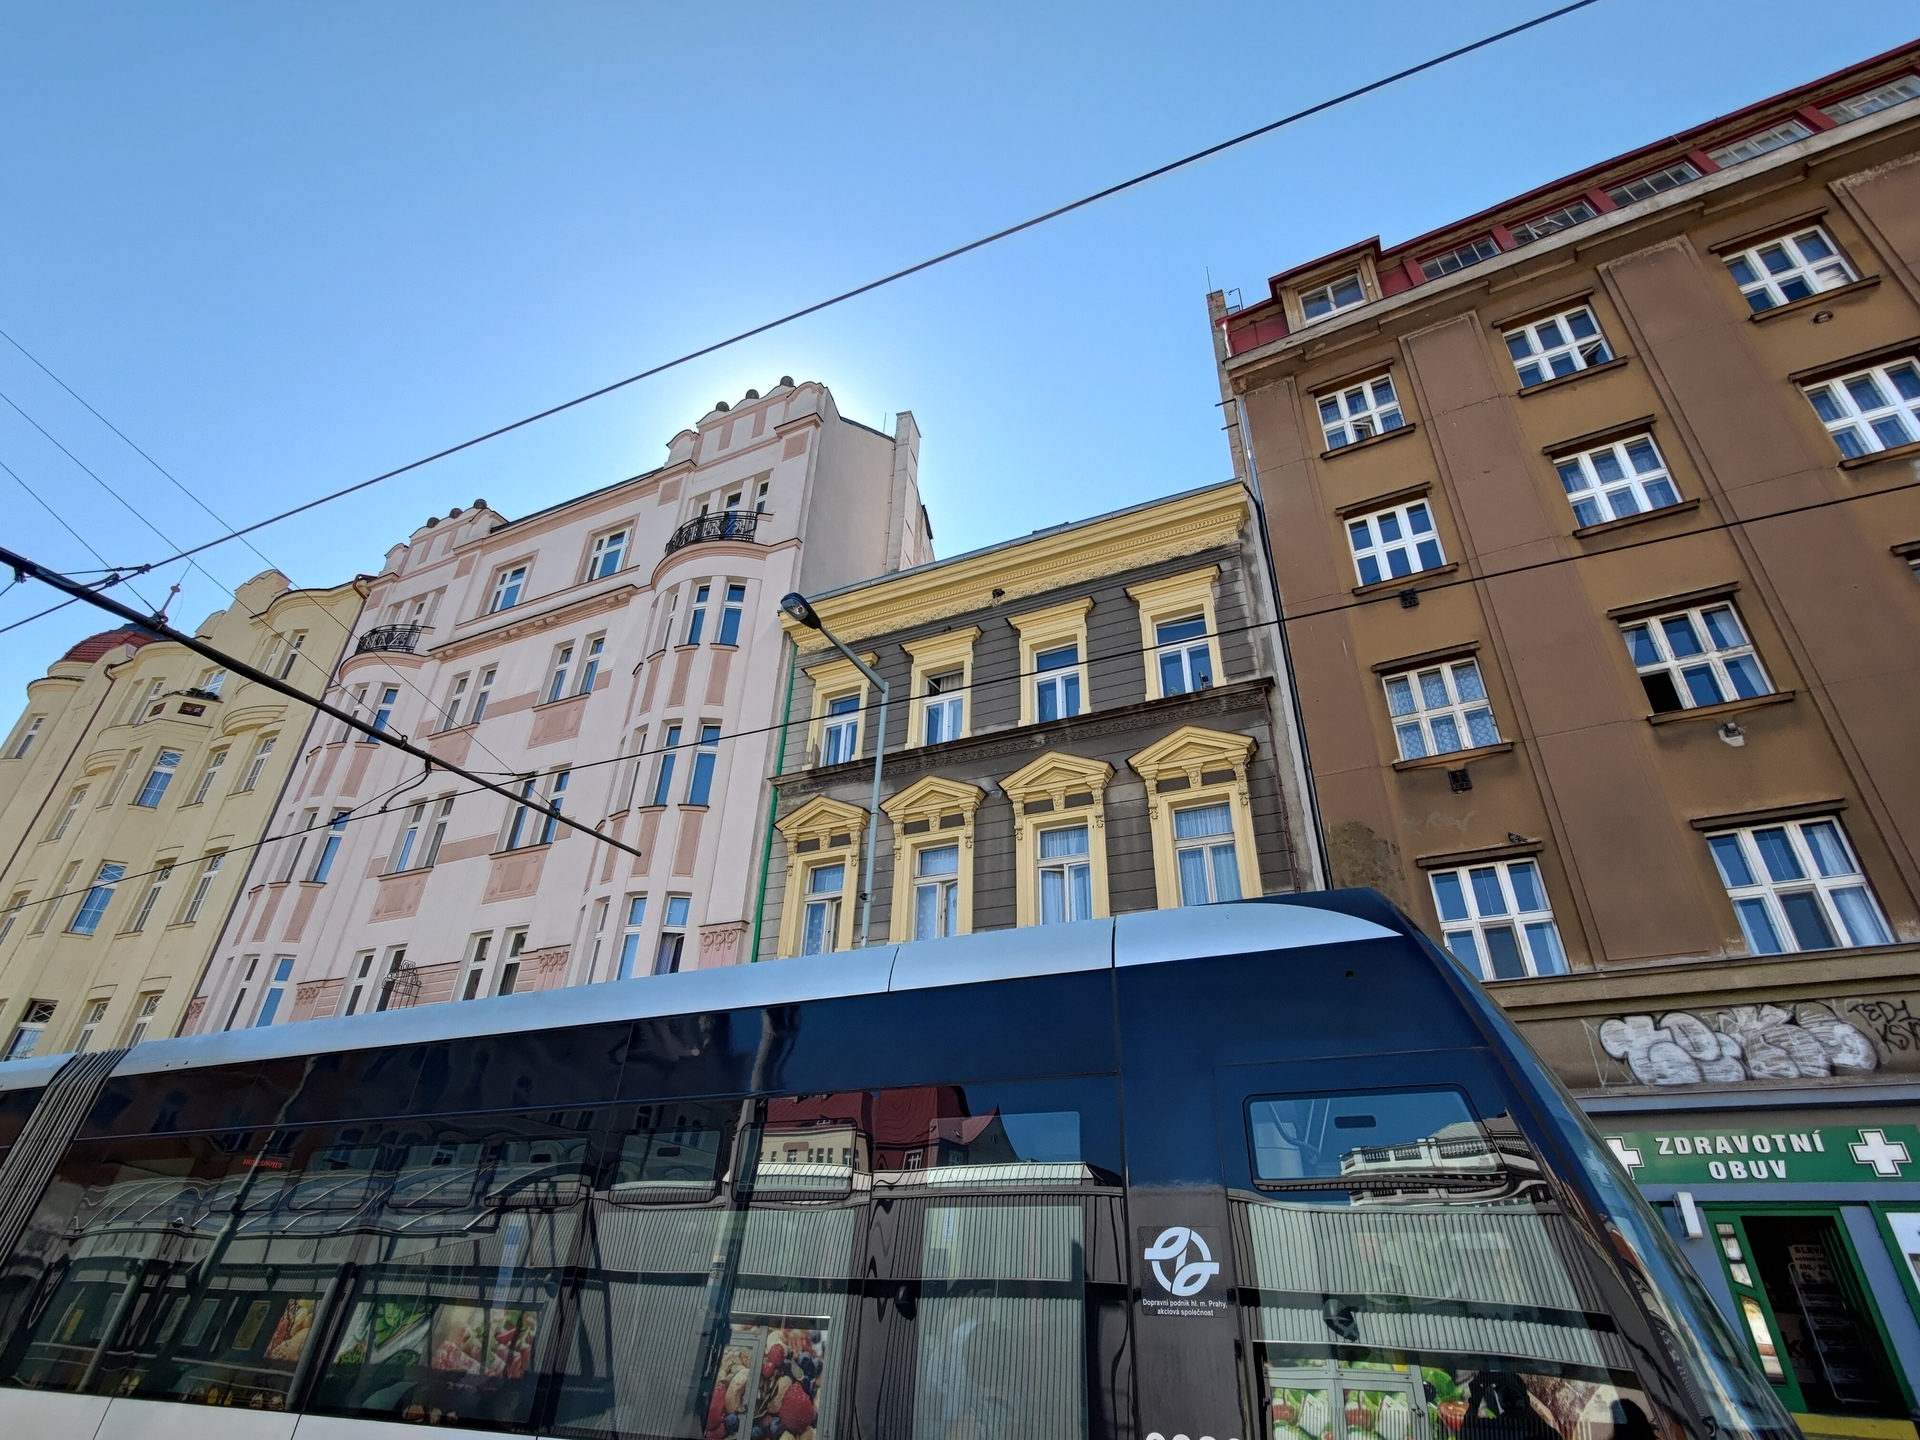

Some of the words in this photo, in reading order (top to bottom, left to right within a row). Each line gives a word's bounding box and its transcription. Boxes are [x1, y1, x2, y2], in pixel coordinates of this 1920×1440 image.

[1655, 1130, 1825, 1155] ZDRAVOTNÍ
[1708, 1160, 1787, 1180] OBUV
[1142, 1298, 1168, 1306] Dopravní
[1208, 1301, 1228, 1309] Prahy,
[1180, 1308, 1213, 1316] společnost
